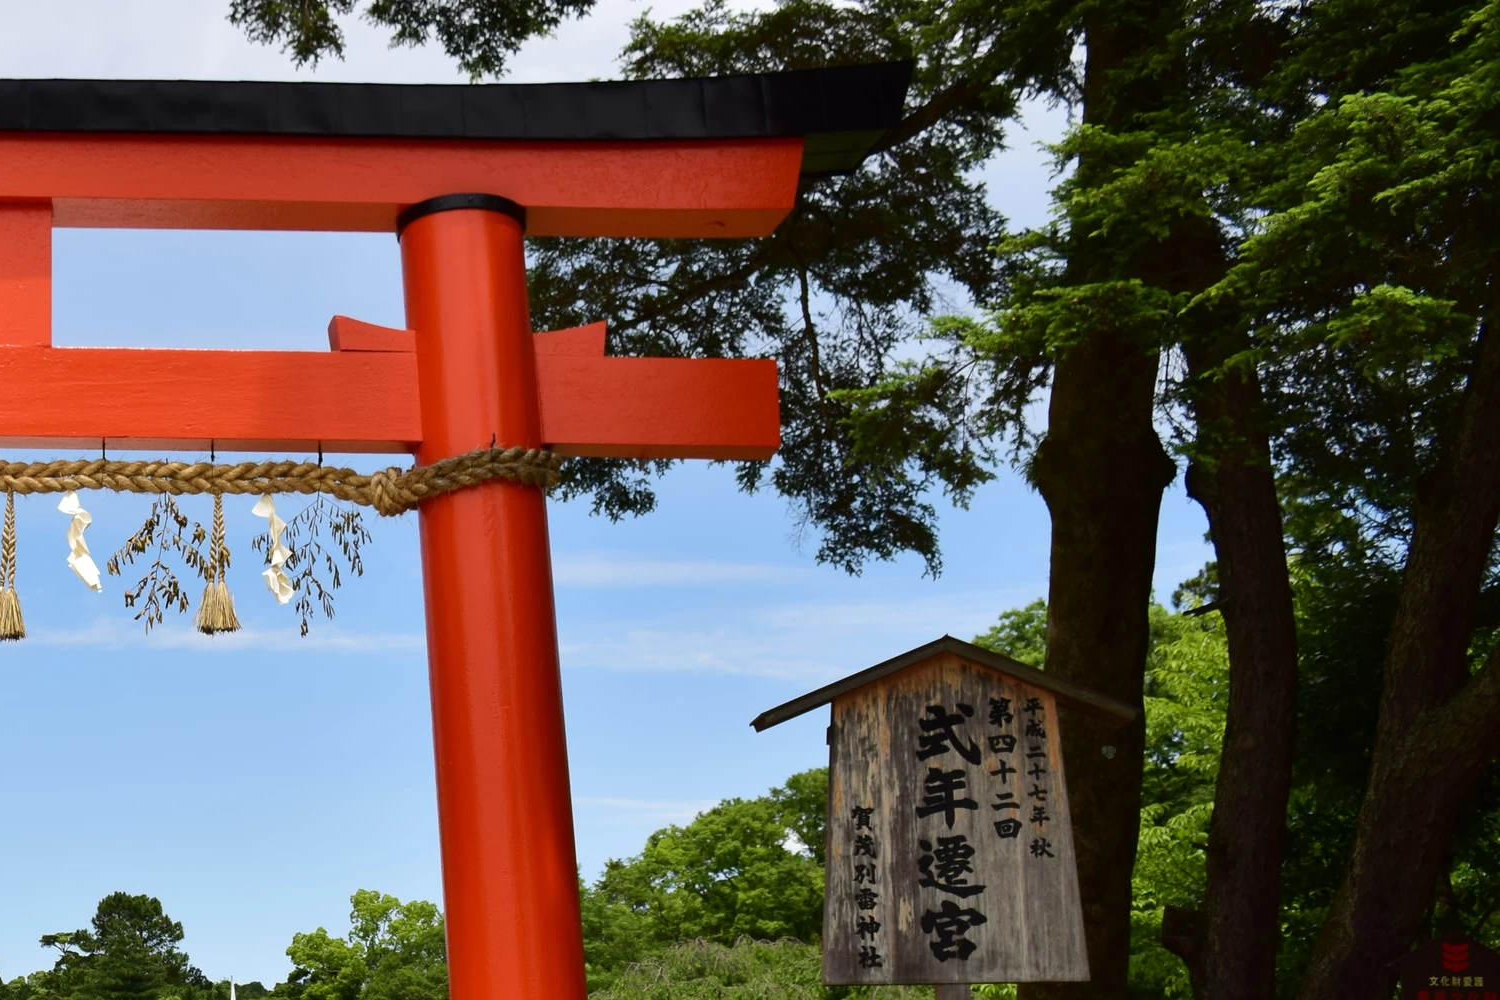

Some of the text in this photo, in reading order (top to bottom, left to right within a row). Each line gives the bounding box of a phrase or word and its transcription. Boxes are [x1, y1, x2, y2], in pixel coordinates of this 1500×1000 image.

[915, 703, 988, 963] 式年遷宮
[987, 697, 1023, 840] 第四十二回
[851, 805, 883, 970] 賀茂別雷神社
